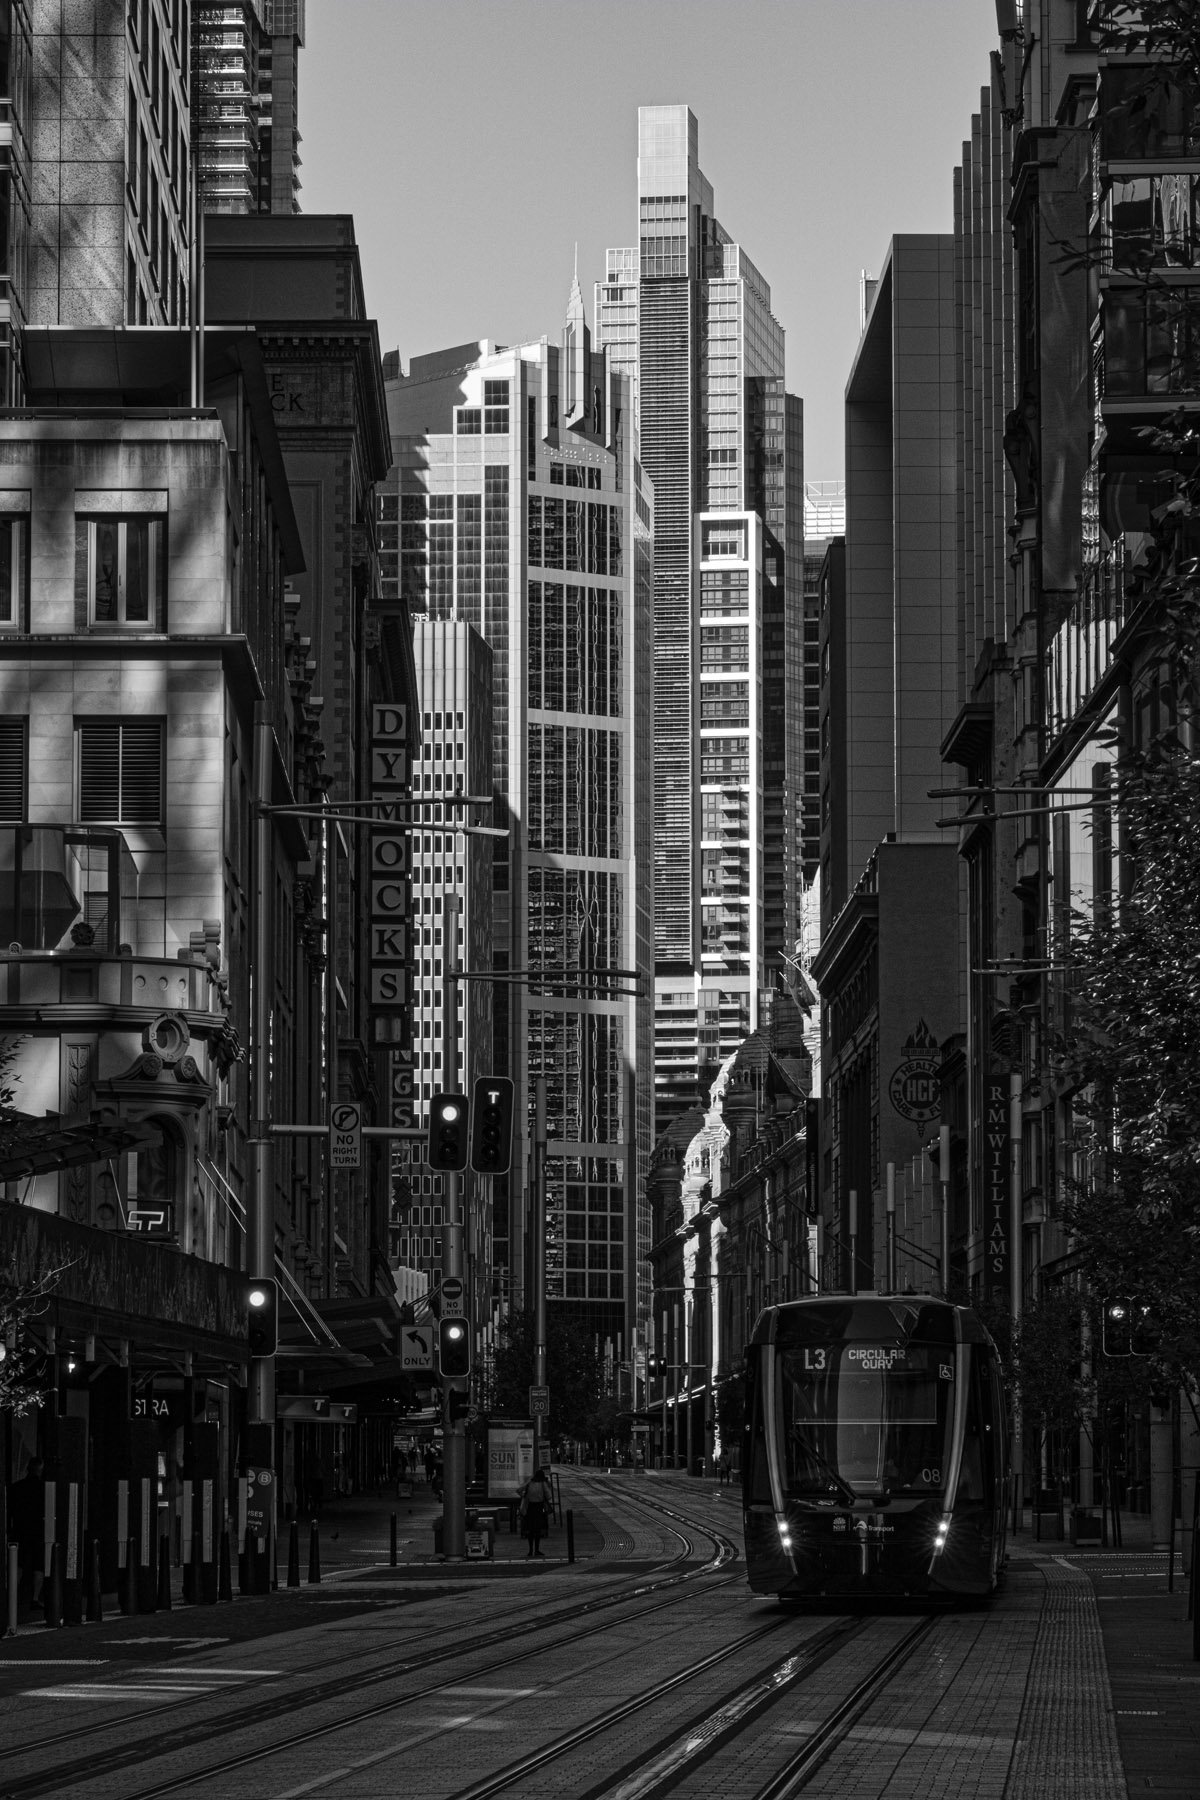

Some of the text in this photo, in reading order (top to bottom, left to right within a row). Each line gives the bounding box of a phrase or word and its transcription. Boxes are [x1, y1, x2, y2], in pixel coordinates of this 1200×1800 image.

[375, 708, 403, 999] DYMOCKS
[906, 1079, 936, 1101] HCF
[892, 1090, 913, 1116] CARE
[336, 1134, 354, 1145] NO
[332, 1147, 358, 1155] RIGHT
[334, 1156, 358, 1164] TURN
[446, 1301, 459, 1309] NO
[804, 1349, 826, 1370] L3
[848, 1349, 906, 1360] CIRCULAR
[403, 1357, 431, 1366] ONLY
[861, 1359, 894, 1370] QUAY
[534, 1401, 545, 1410] 20
[490, 1452, 516, 1464] SUN
[260, 1473, 269, 1483] B
[922, 1468, 941, 1483] 08
